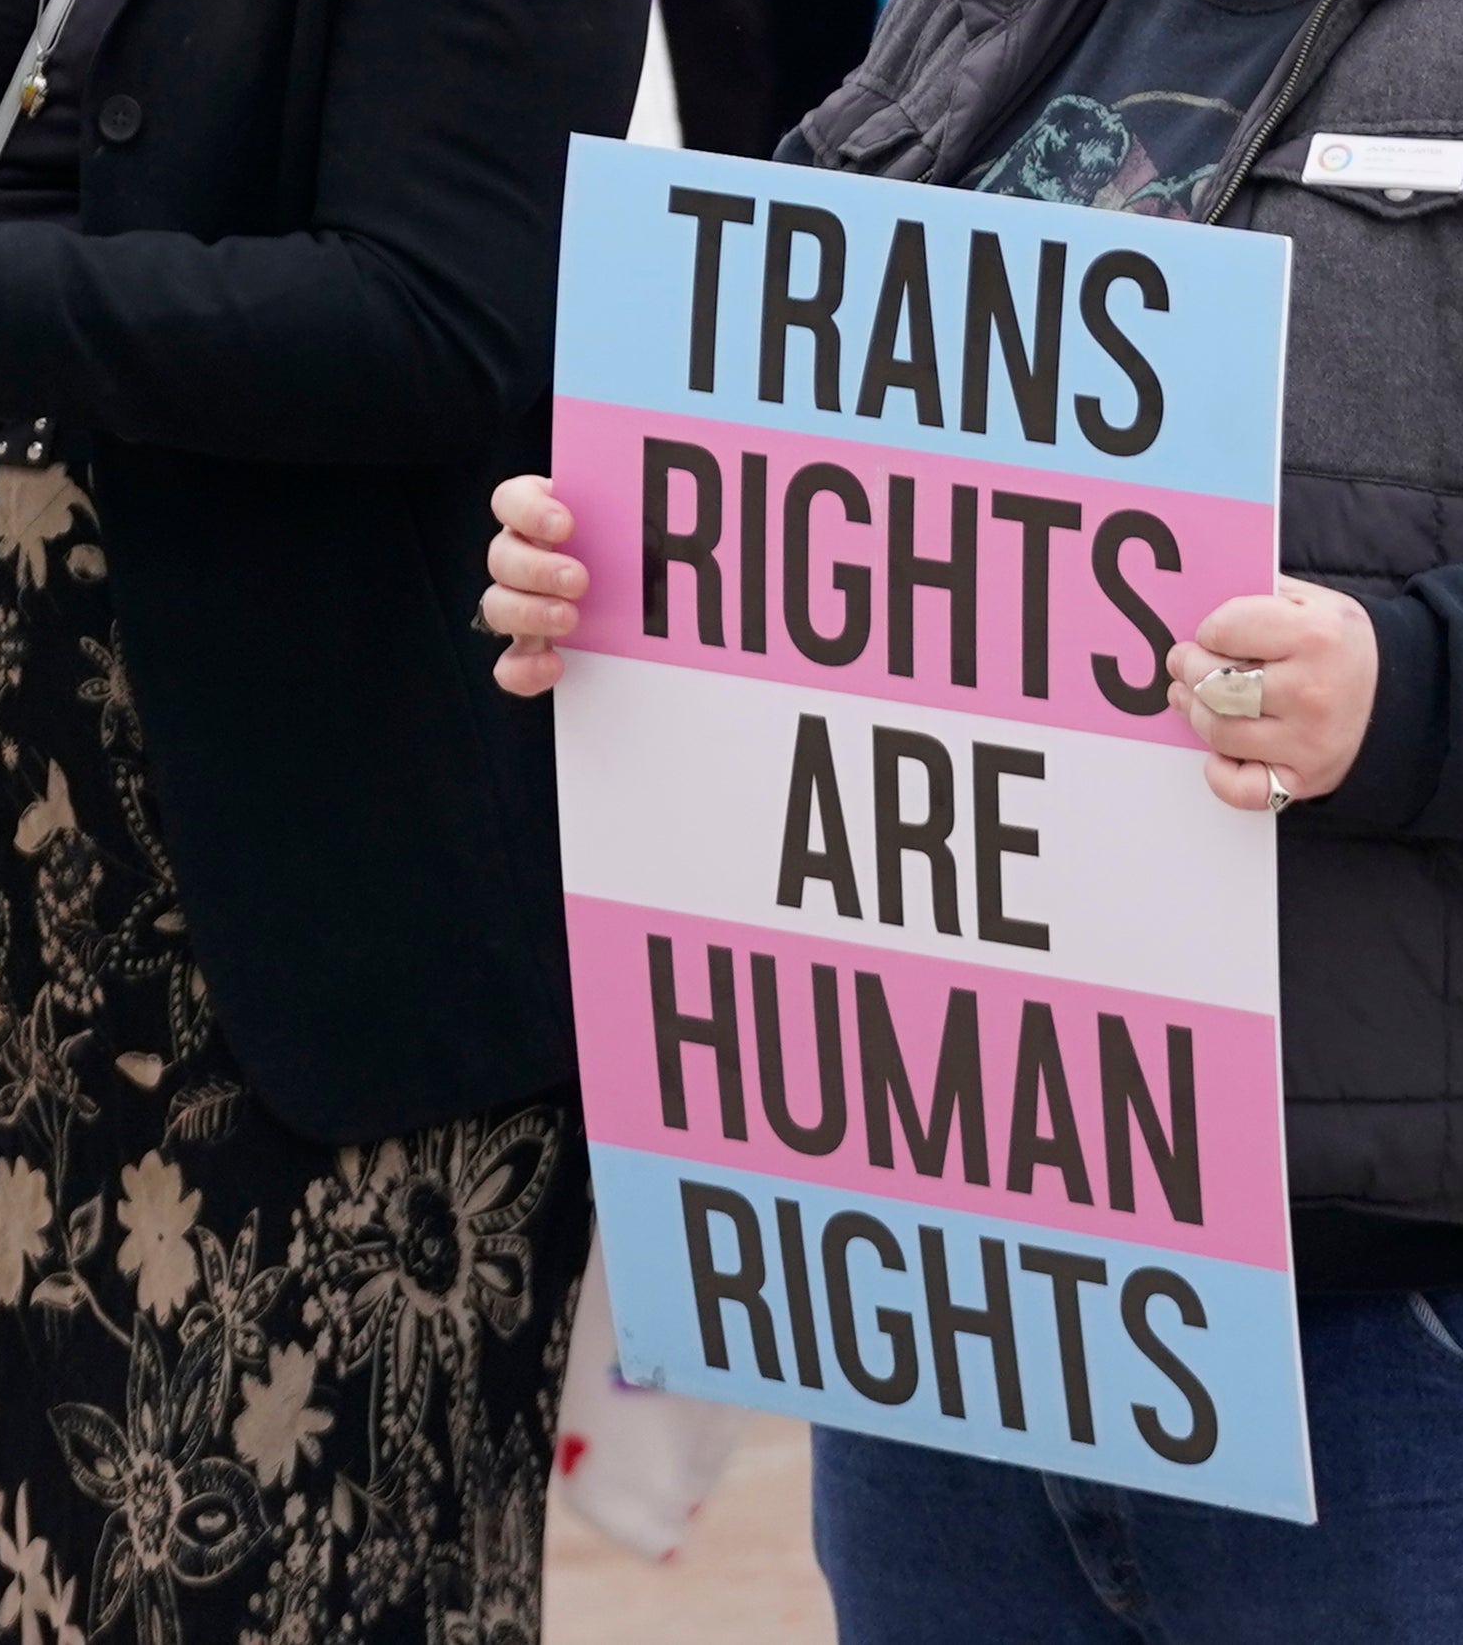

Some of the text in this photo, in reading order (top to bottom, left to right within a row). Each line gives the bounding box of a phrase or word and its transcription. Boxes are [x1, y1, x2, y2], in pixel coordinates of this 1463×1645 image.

[668, 184, 1171, 458] TRANS
[642, 437, 1185, 717] RIGHTS
[776, 713, 1051, 952] ARE
[647, 932, 1205, 1228] HUMAN
[679, 1178, 1219, 1466] RIGHTS
